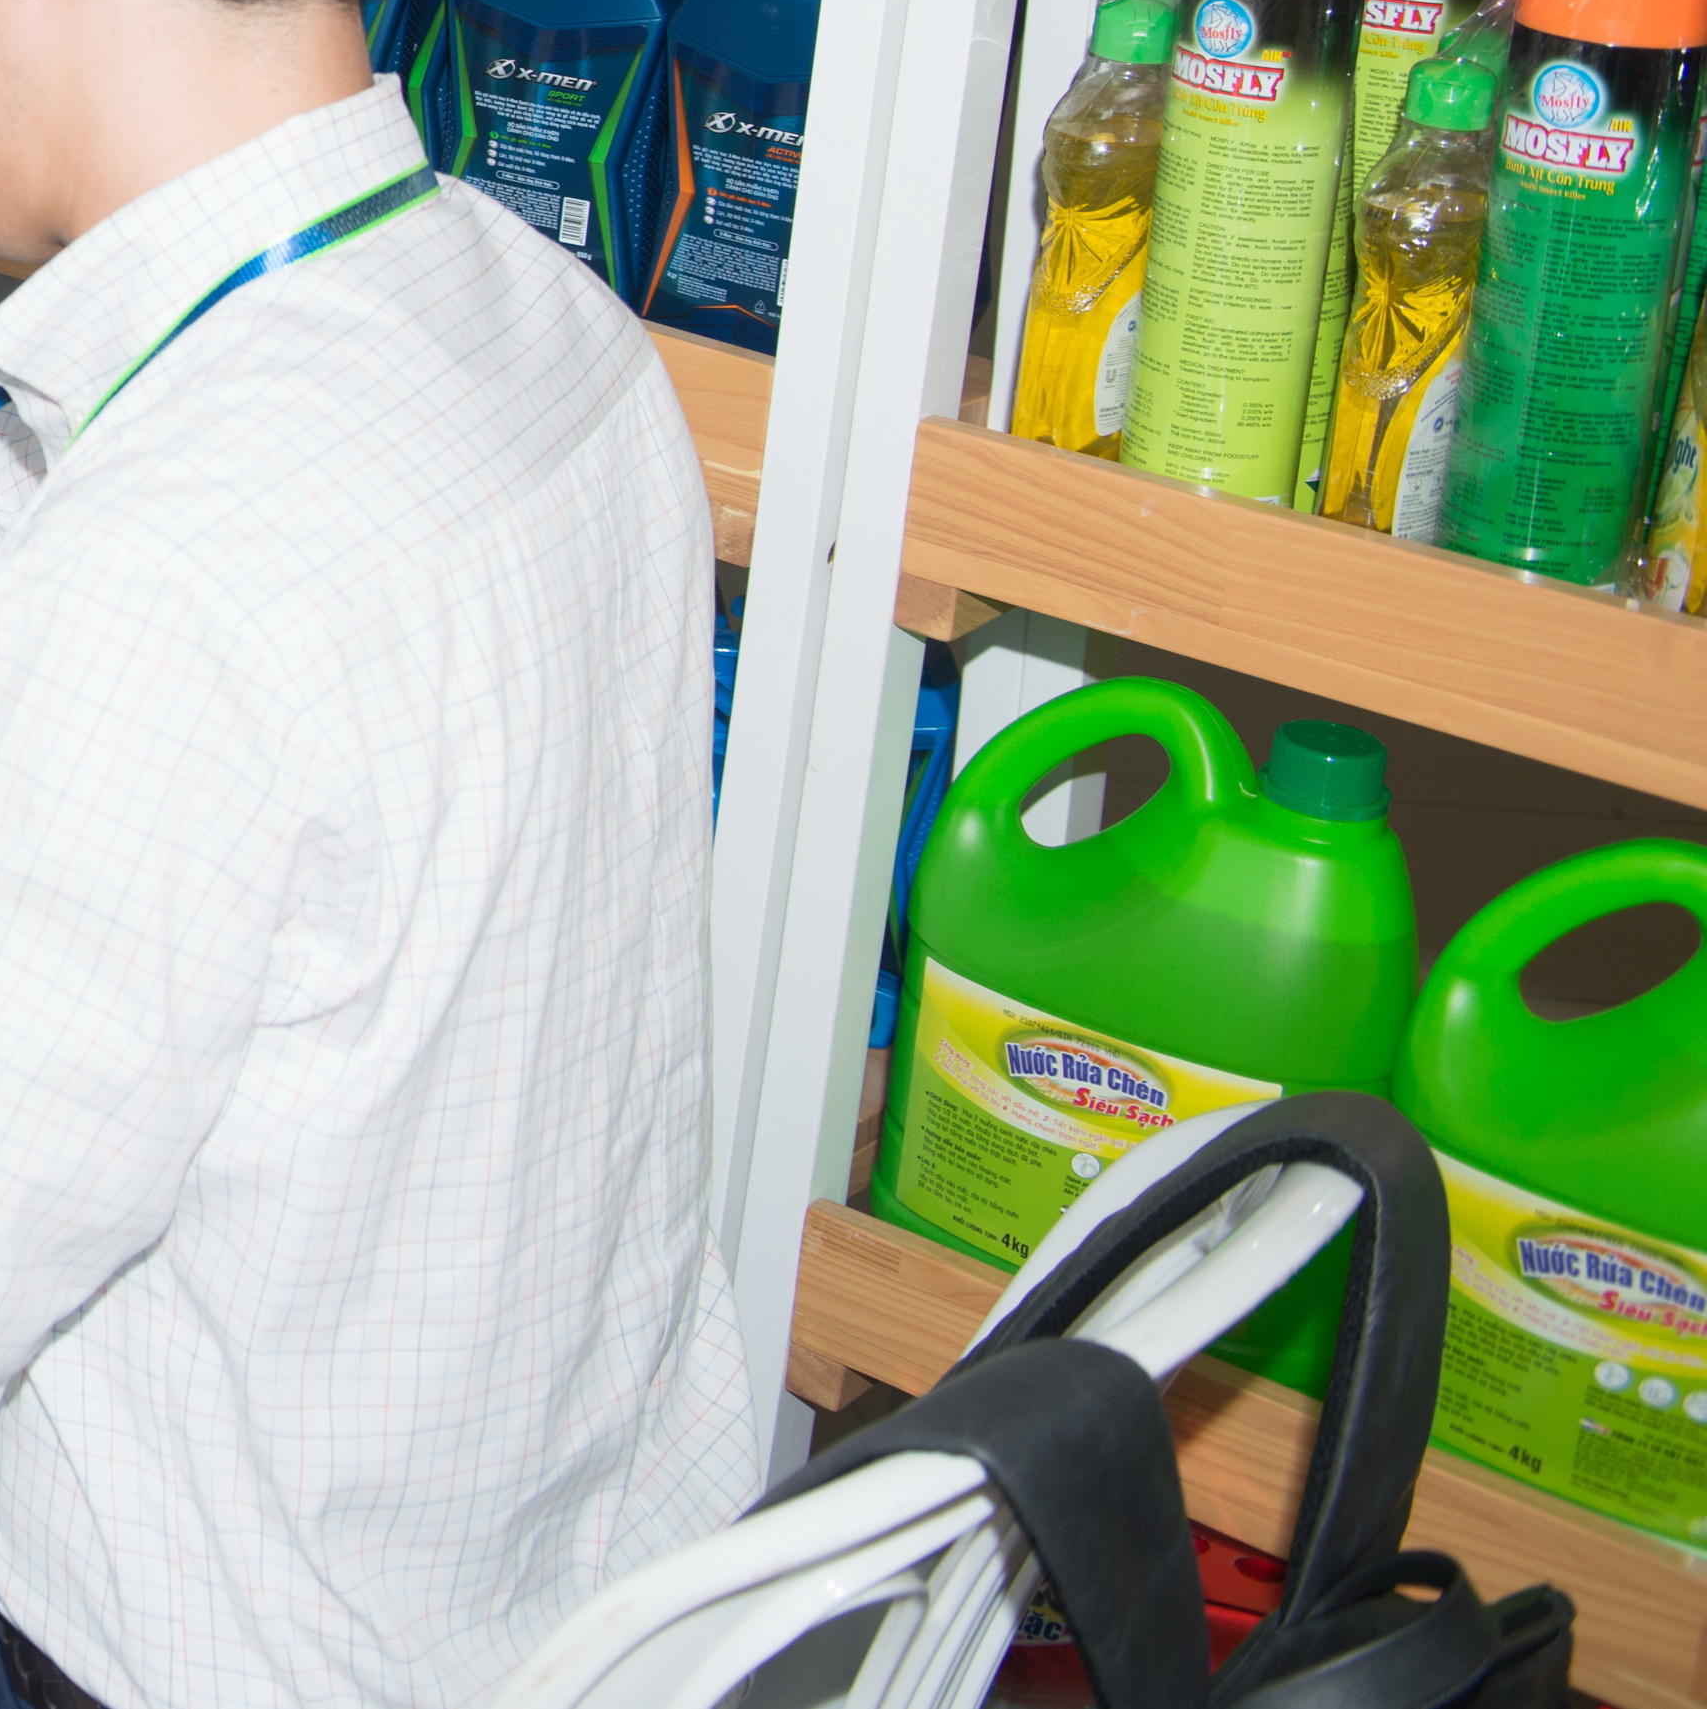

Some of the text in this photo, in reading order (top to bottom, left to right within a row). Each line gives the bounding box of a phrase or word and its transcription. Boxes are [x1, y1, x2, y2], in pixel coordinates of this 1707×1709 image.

[1199, 25, 1242, 42] Mosfly
[516, 67, 594, 91] X-MEN
[1173, 49, 1281, 98] MOSFLY
[547, 90, 586, 103] SPORT
[1538, 93, 1589, 110] Mosfly
[1206, 98, 1227, 114] Côn
[1230, 102, 1267, 123] Trùng
[767, 146, 802, 159] ACTIV
[1504, 117, 1632, 171] MOSFLY
[1207, 162, 1240, 173] DIRECTION
[1241, 168, 1255, 176] FOR
[1505, 157, 1615, 196] Bình Xịt Côn Trùng
[1198, 221, 1226, 232] CAUTION
[1189, 287, 1223, 300] SYMPTOMS
[1236, 295, 1271, 303] POISONING
[1186, 313, 1203, 322] FIRST
[1179, 359, 1245, 375] MEDICAL TREATMENT
[1176, 378, 1206, 389] CONTENT
[1167, 449, 1212, 463] AND CHILDREN
[1168, 443, 1259, 460] KEEP AWAY FROM FOODSTUFF
[1006, 1044, 1166, 1109] Nước Rửa Chén
[1074, 1087, 1174, 1129] Siêu Sạch
[1518, 1239, 1706, 1313] Nước Rửa Chén
